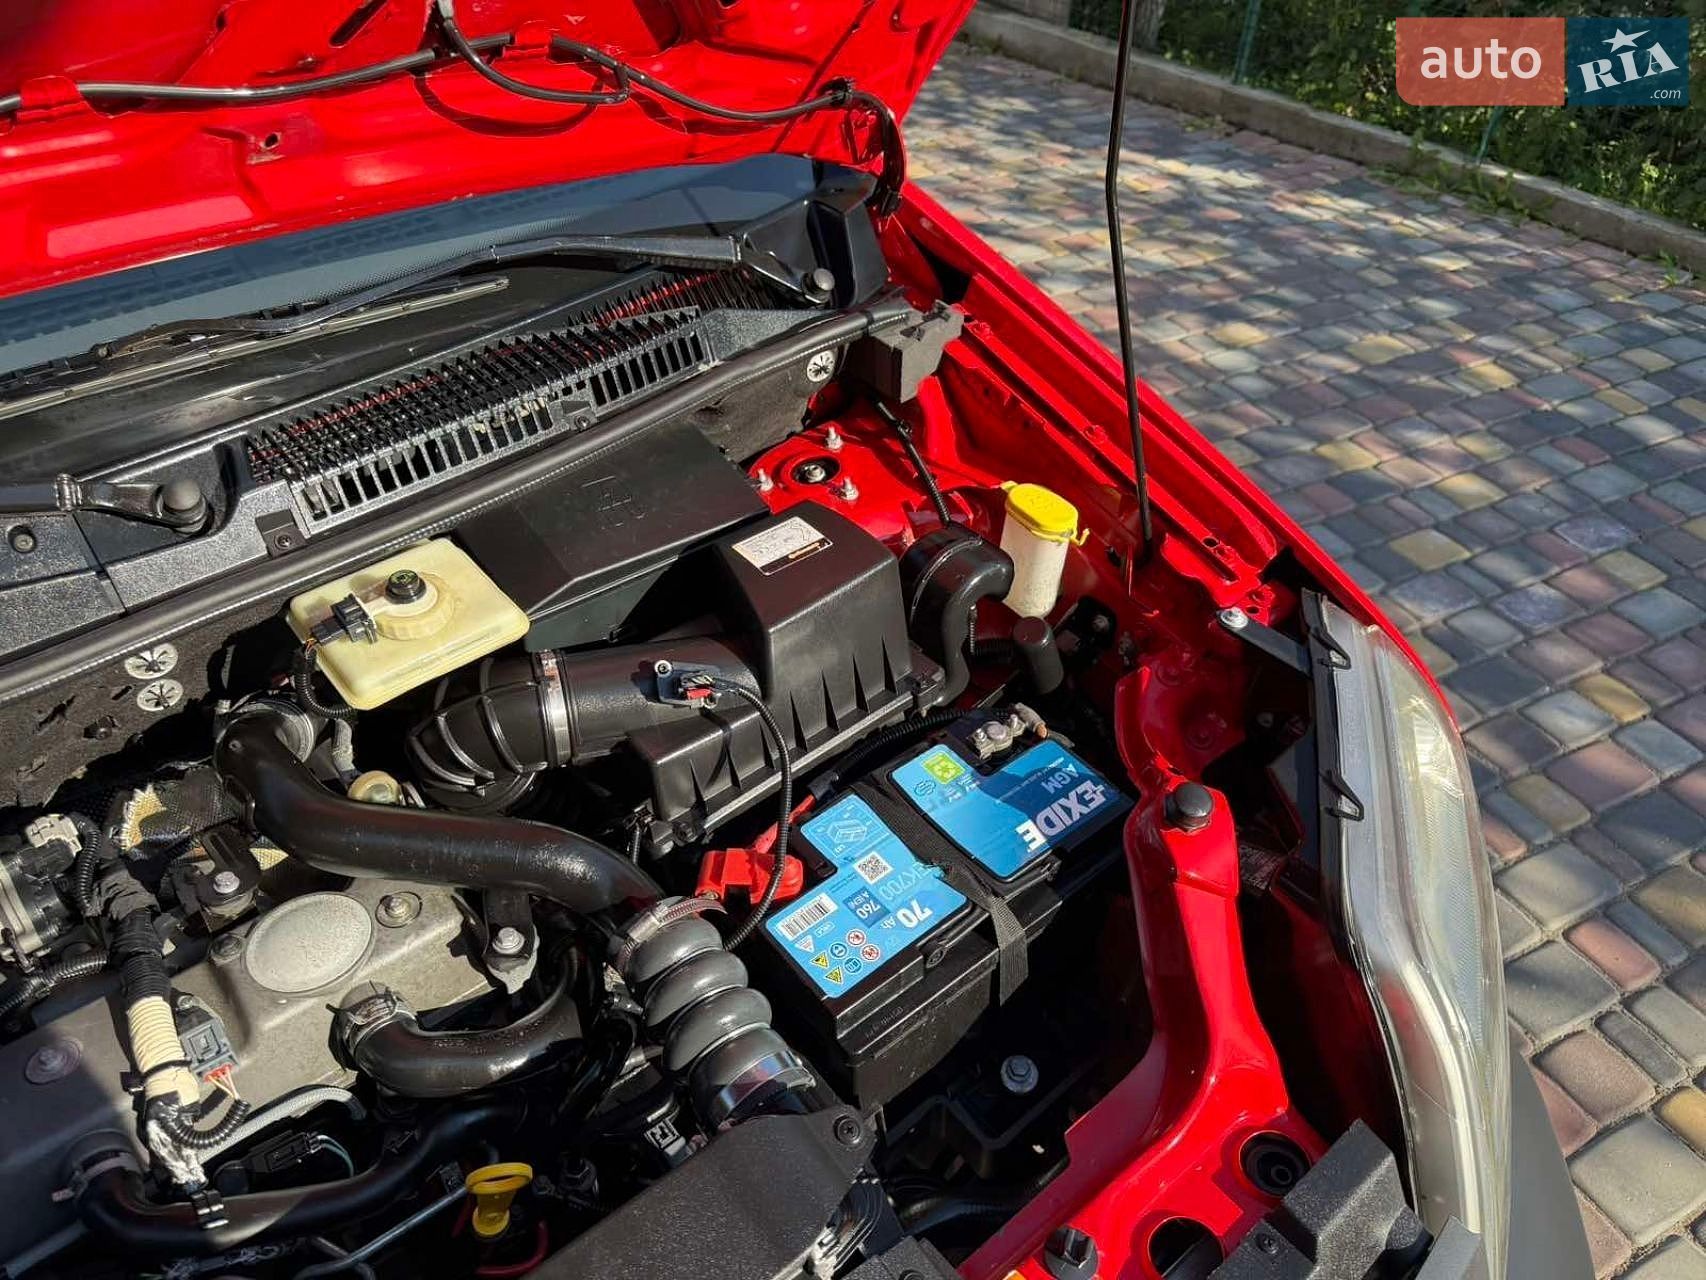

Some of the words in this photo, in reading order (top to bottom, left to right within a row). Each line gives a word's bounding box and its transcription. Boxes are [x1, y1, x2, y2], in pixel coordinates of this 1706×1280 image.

[1041, 763, 1079, 794] AGM
[1015, 780, 1107, 853] EXIDE
[856, 903, 881, 919] 760
[880, 916, 897, 930] Ah
[896, 899, 934, 928] 70
